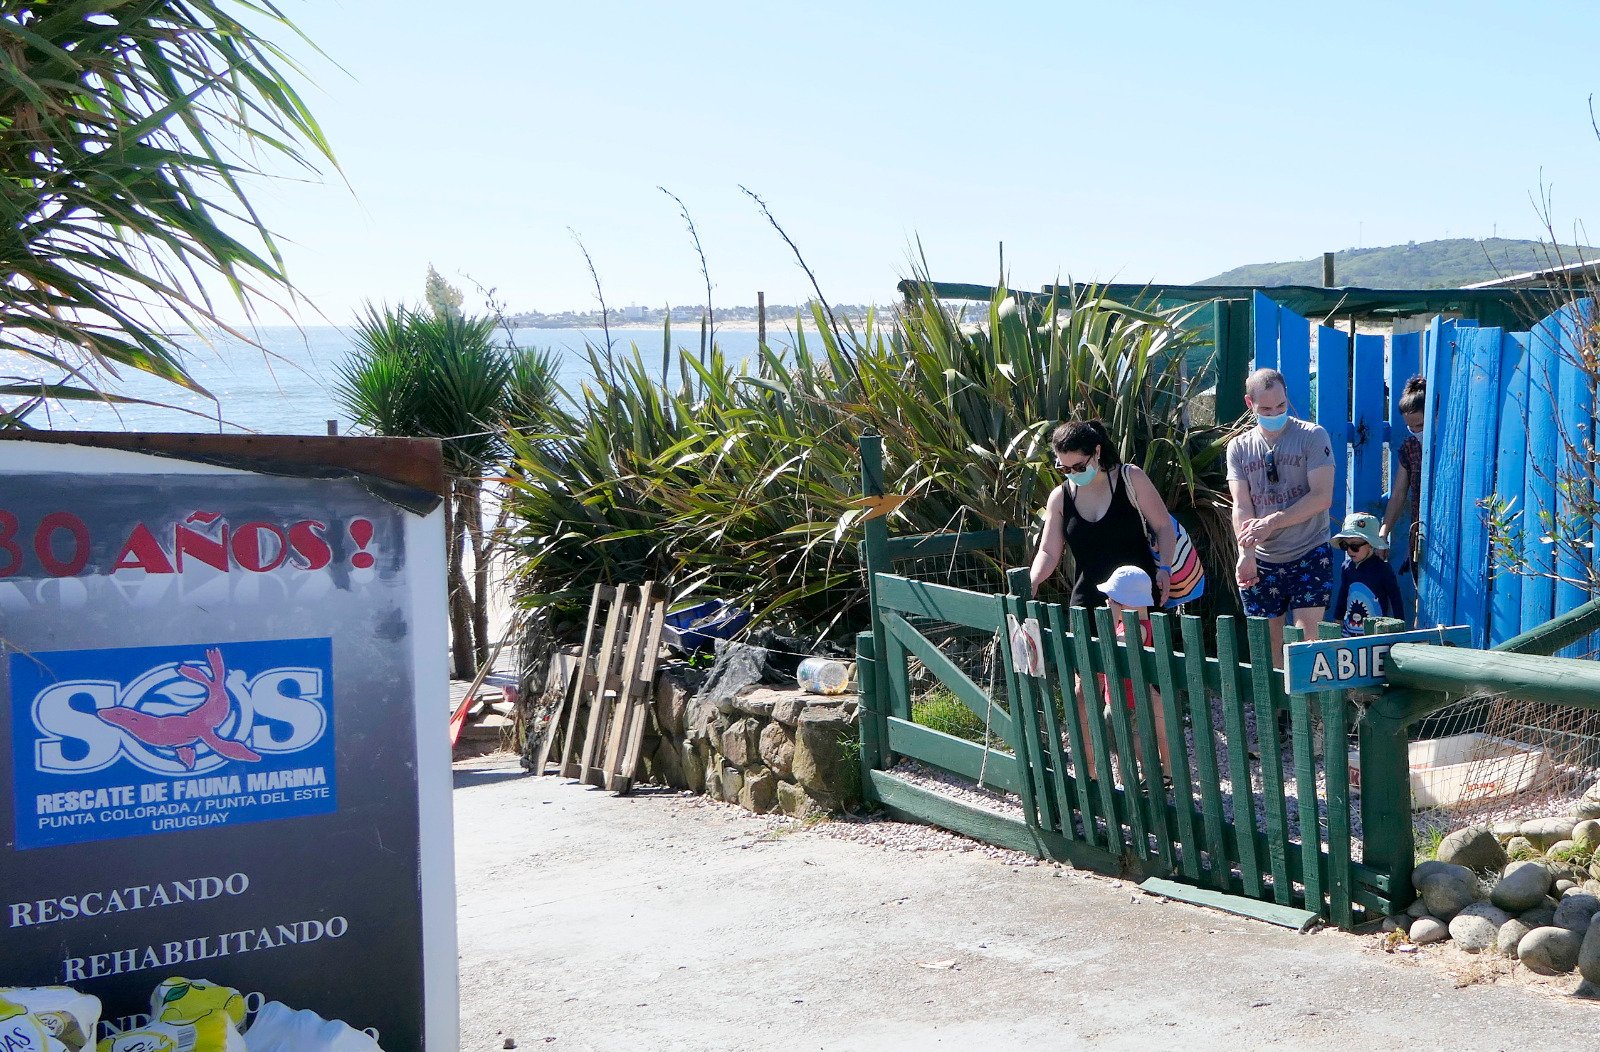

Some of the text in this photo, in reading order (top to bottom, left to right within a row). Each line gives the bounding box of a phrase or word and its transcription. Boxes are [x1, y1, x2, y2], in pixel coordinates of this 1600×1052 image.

[1310, 644, 1390, 683] ABIE
[36, 766, 327, 815] RESCATE DE FAUNA MARINA
[38, 813, 96, 829] PUNTA
[100, 801, 190, 821] COLORADA
[206, 793, 257, 810] PUNTA
[261, 791, 290, 804] DEL
[294, 786, 330, 800] ESTE
[152, 811, 230, 832] URUGUAY
[9, 872, 250, 929] RESCATANDO
[63, 916, 349, 983] REHABILITANDO
